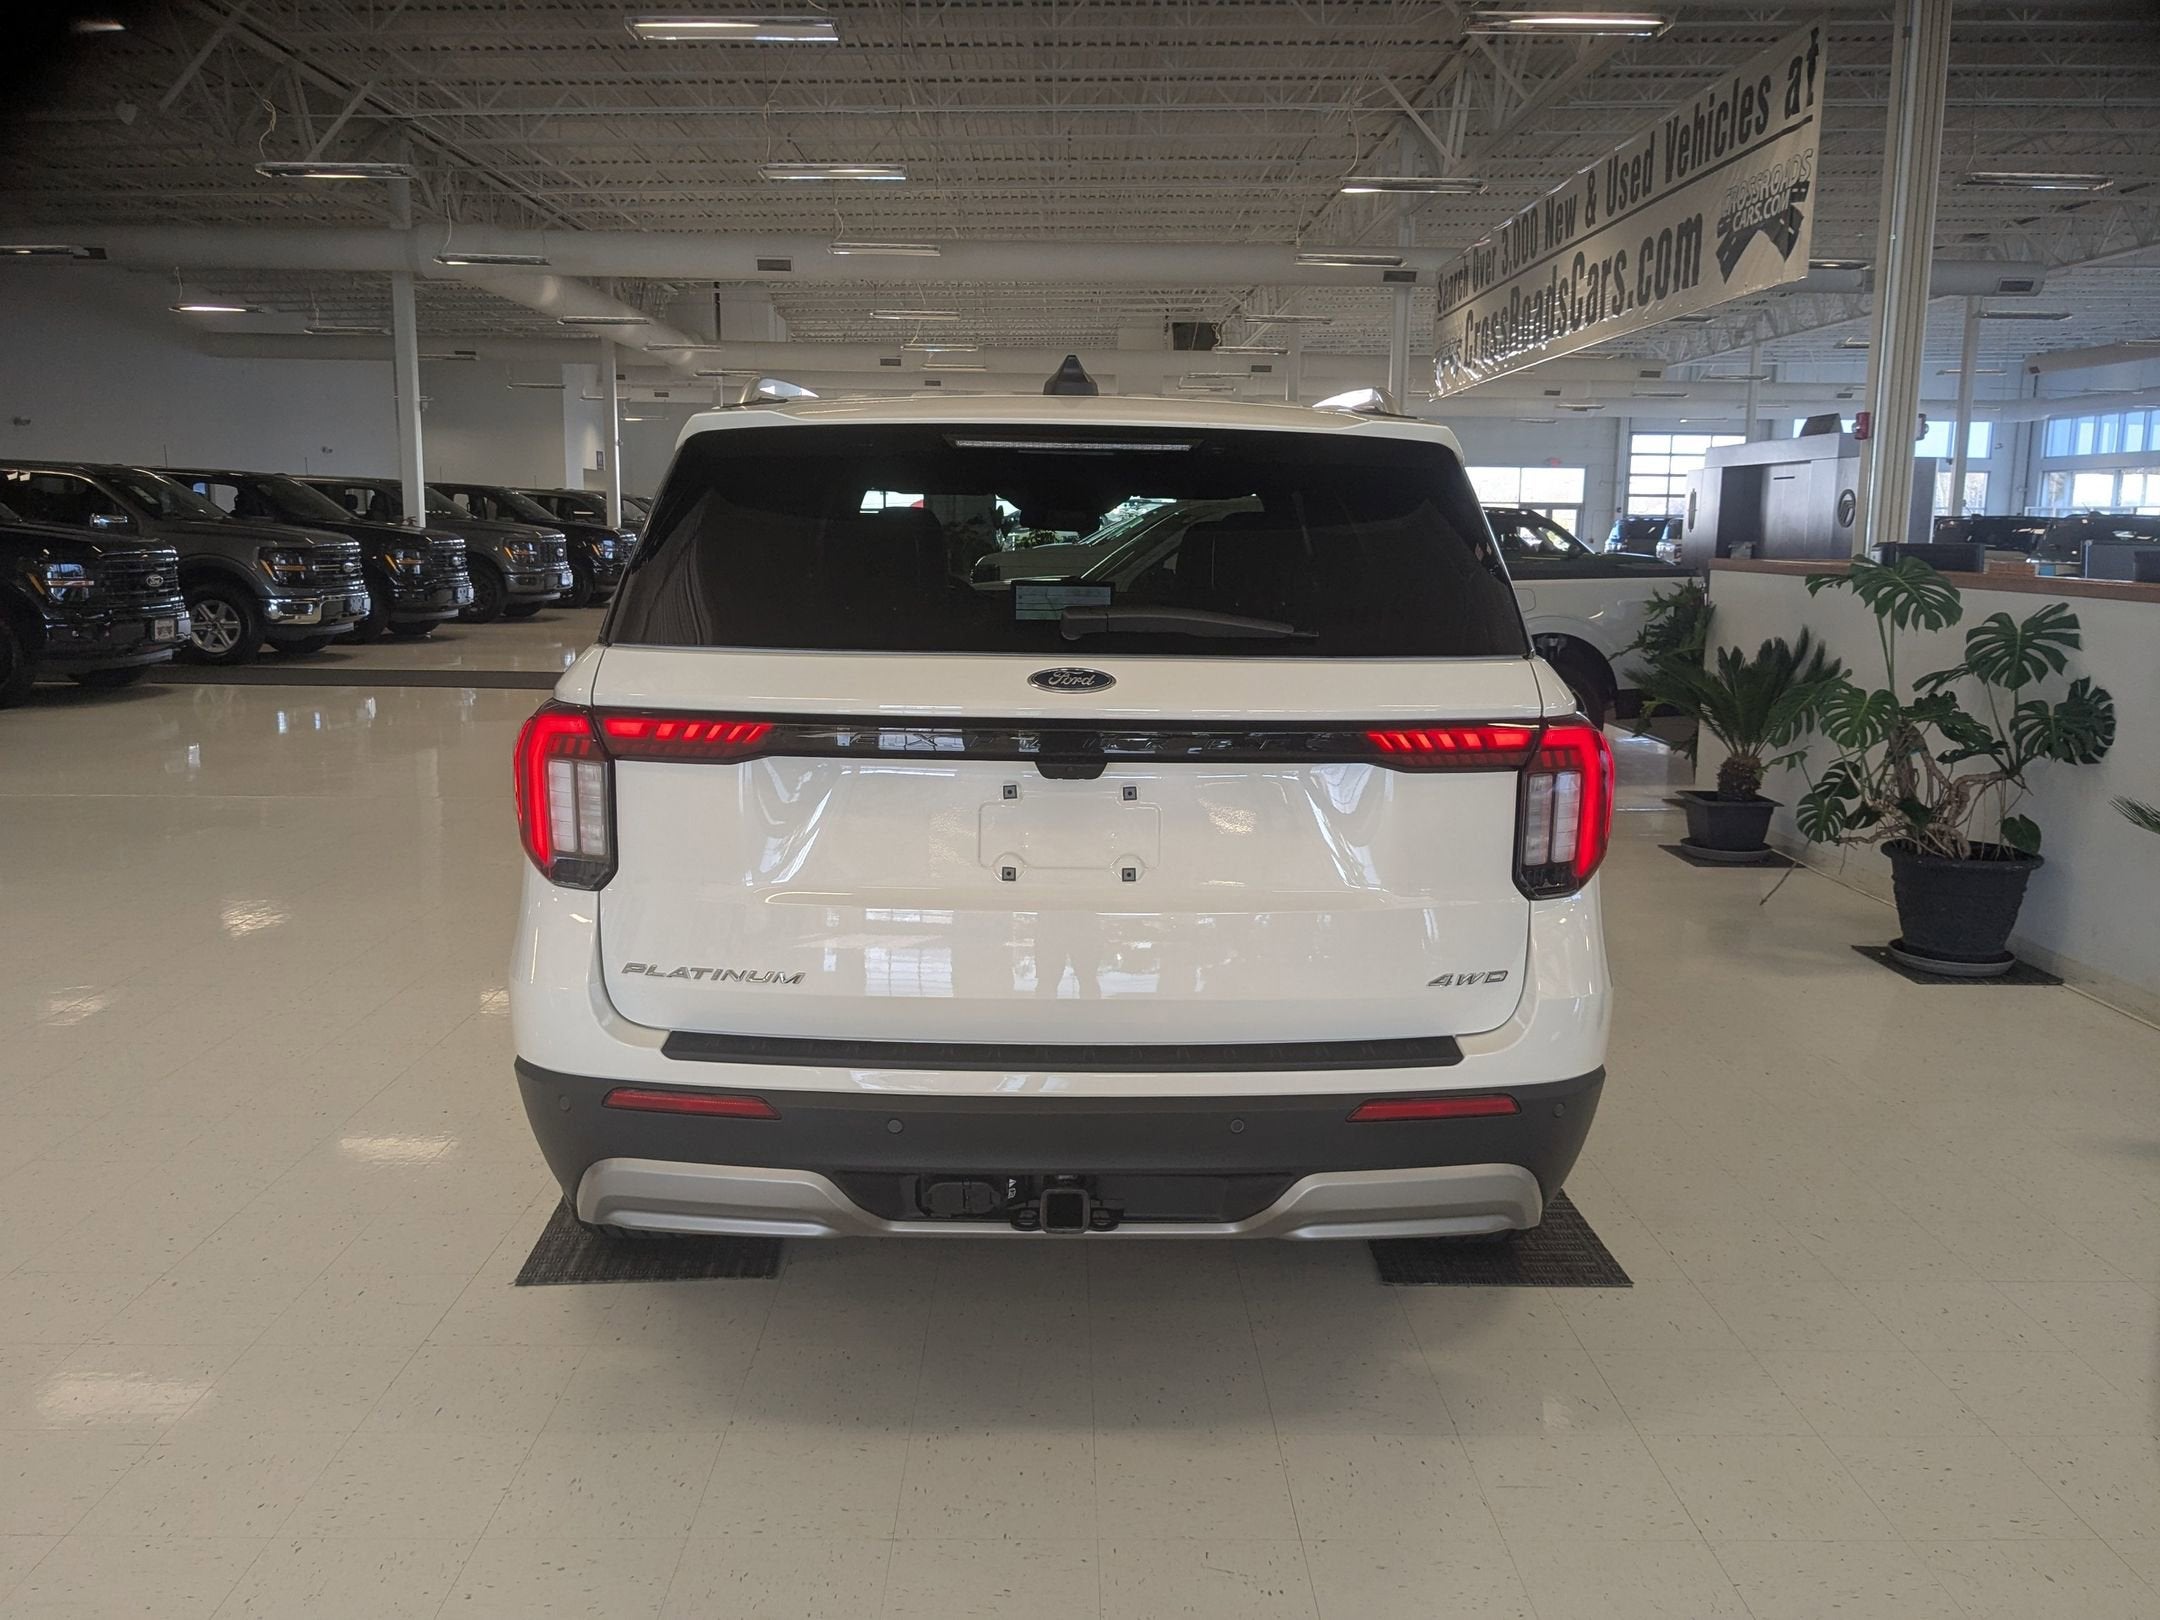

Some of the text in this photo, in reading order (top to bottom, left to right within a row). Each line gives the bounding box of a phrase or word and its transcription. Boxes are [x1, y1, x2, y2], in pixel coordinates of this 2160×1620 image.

[1437, 27, 1821, 313] Search Over 3,000 New & Used Vehicles at
[1733, 187, 1790, 232] CARS.COM
[1464, 212, 1703, 369] CrossRoadsCars.com
[622, 962, 806, 984] PLATINUM
[1427, 970, 1508, 986] 4WD
